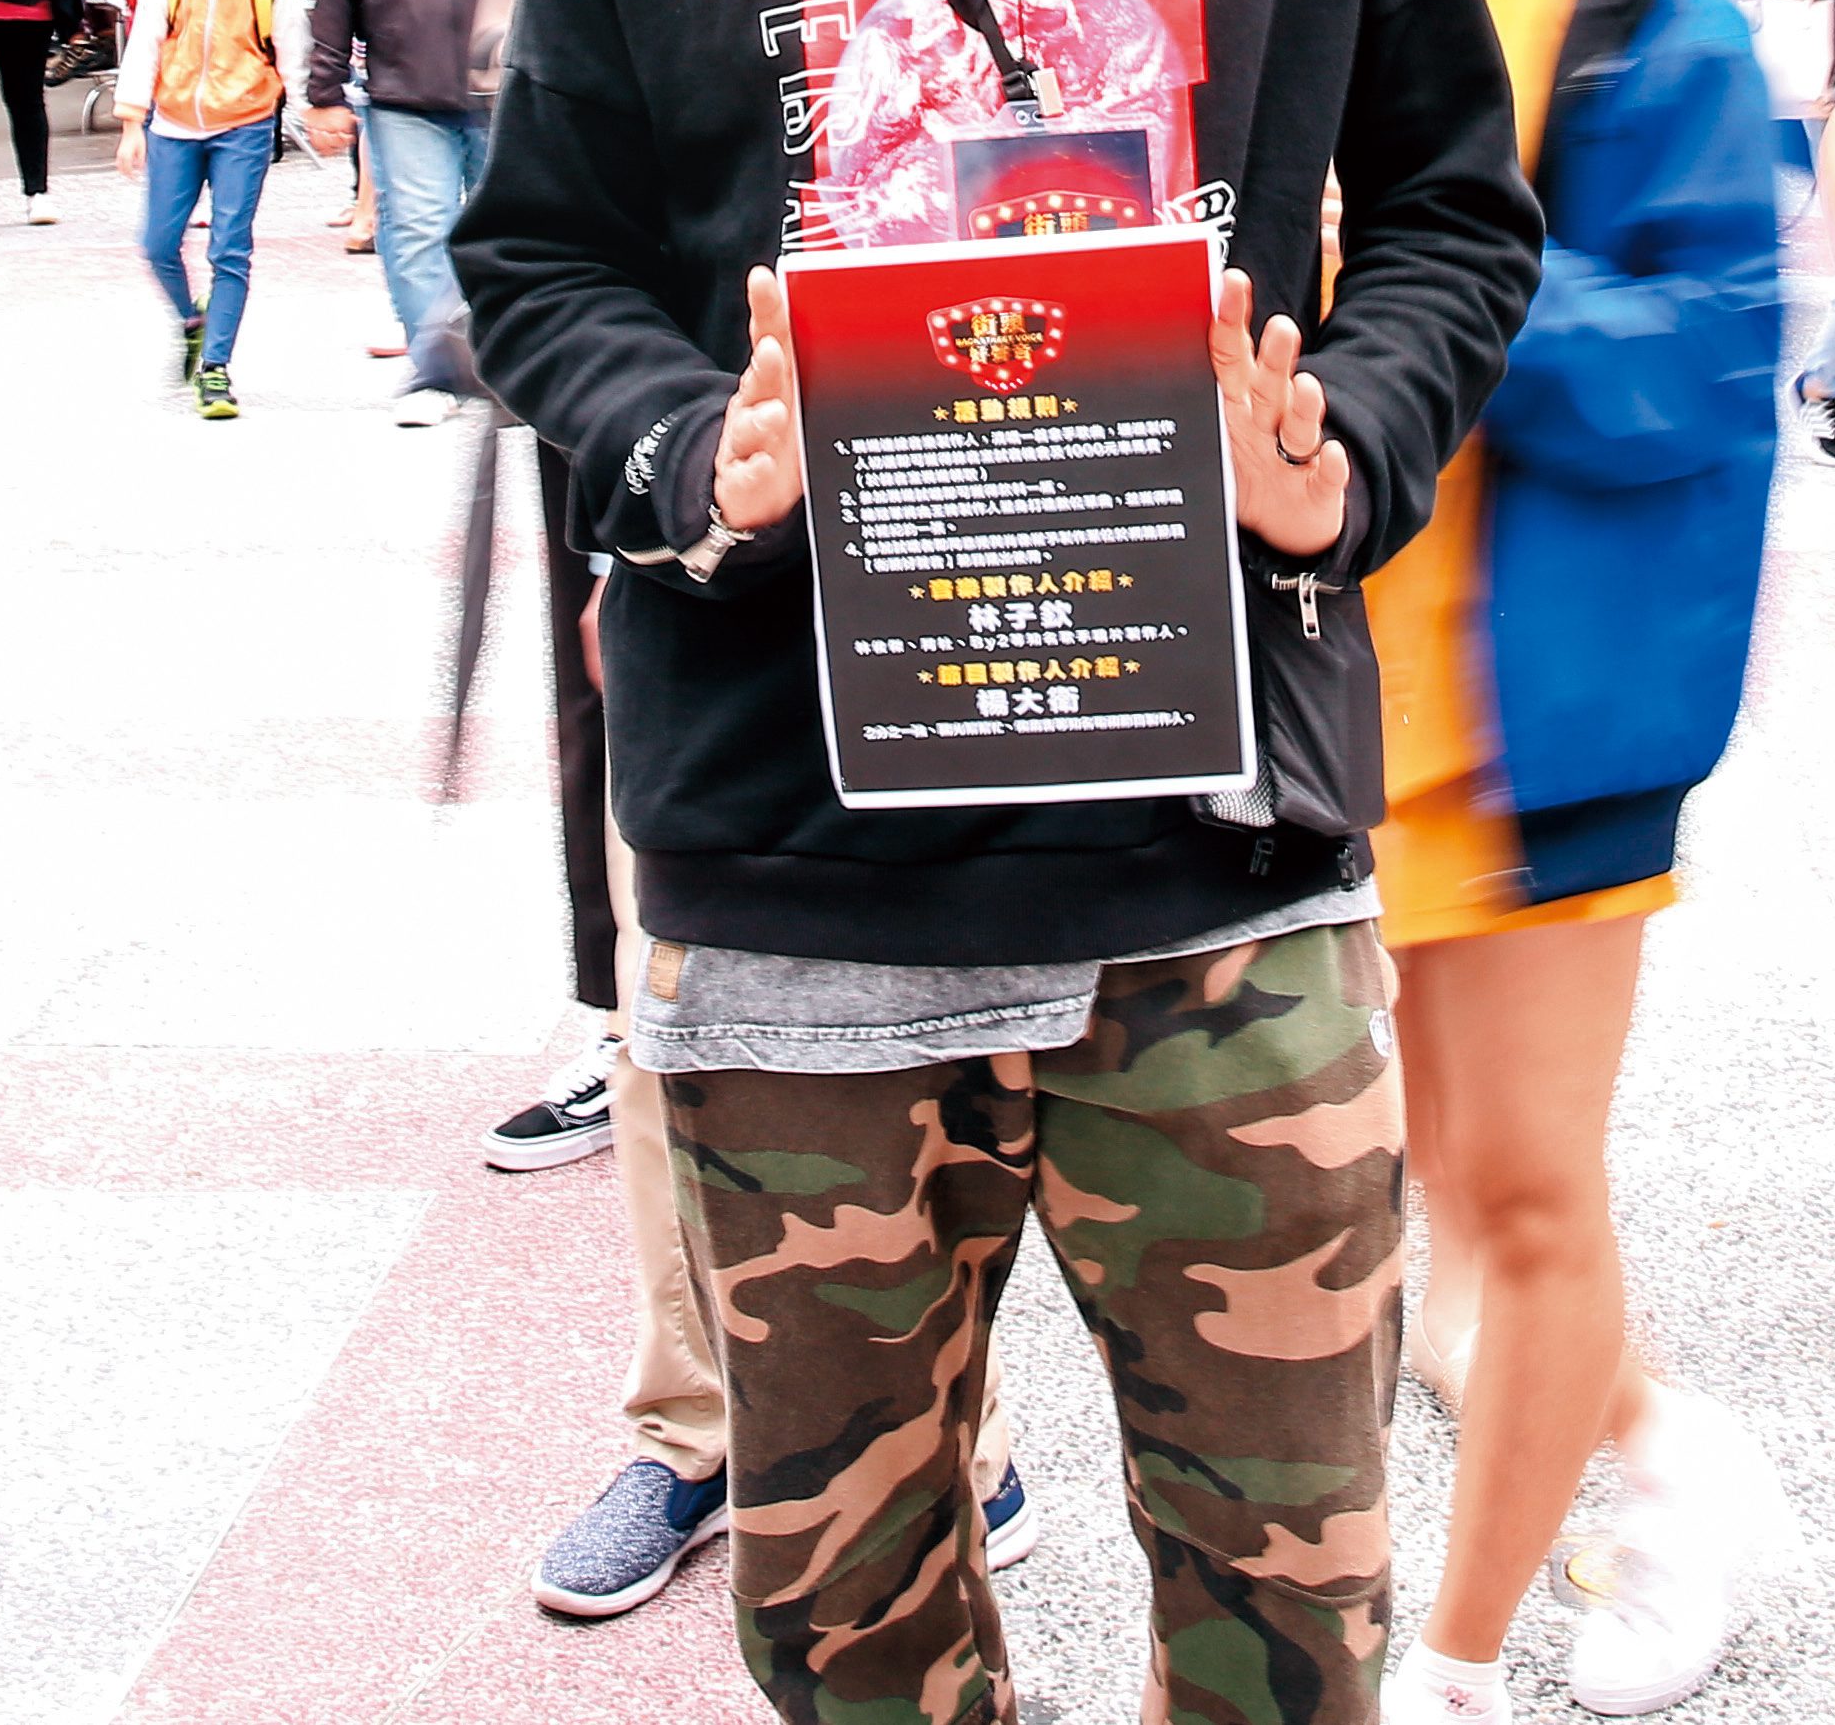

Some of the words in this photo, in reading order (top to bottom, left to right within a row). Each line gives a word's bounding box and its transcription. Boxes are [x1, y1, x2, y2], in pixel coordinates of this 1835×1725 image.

[952, 393, 1059, 424] 活動規則
[928, 569, 1113, 602] 音樂製作人介紹
[967, 598, 1075, 633] 林子欽
